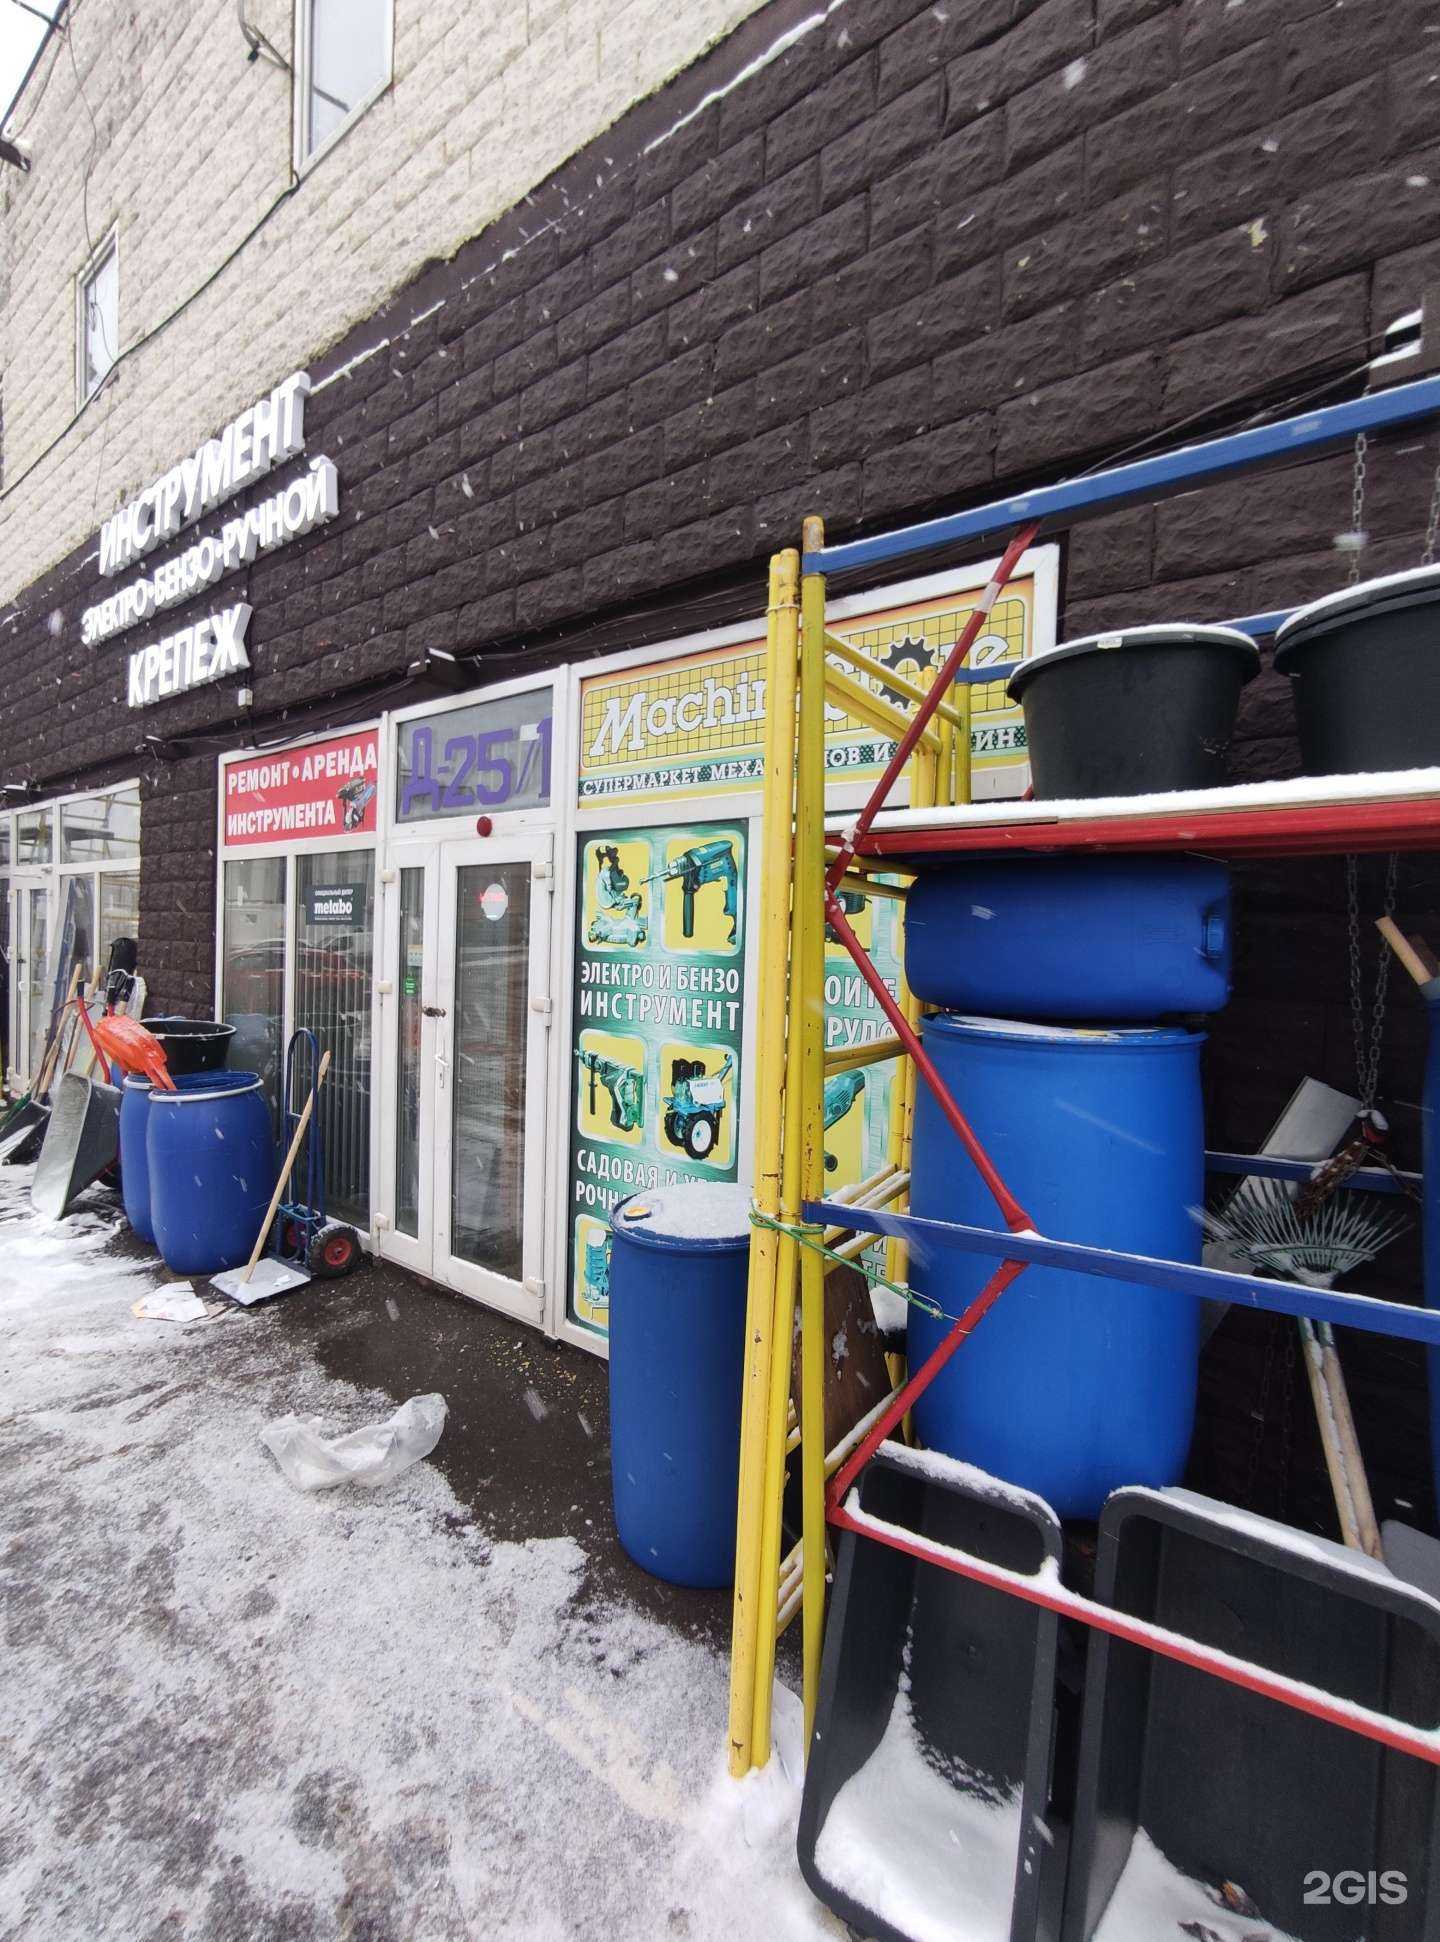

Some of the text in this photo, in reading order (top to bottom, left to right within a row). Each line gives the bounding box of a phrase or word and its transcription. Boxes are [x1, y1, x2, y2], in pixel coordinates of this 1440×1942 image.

[99, 370, 311, 577] ИНСТРУМЕНТ
[127, 602, 253, 708] КРЕПЕЖ
[228, 743, 377, 796] РЕМОНТ АРЕНДА
[583, 767, 701, 795] СУПЕРМАРКЕТ
[227, 799, 336, 837] ИНСТРУМЕНТА
[314, 899, 353, 914] metabo
[581, 961, 739, 994] ЭЛЕКТРО И БЕНЗО
[580, 989, 740, 1031] ИНСТРУМЕНТ
[577, 1149, 659, 1189] САДОВАЯ
